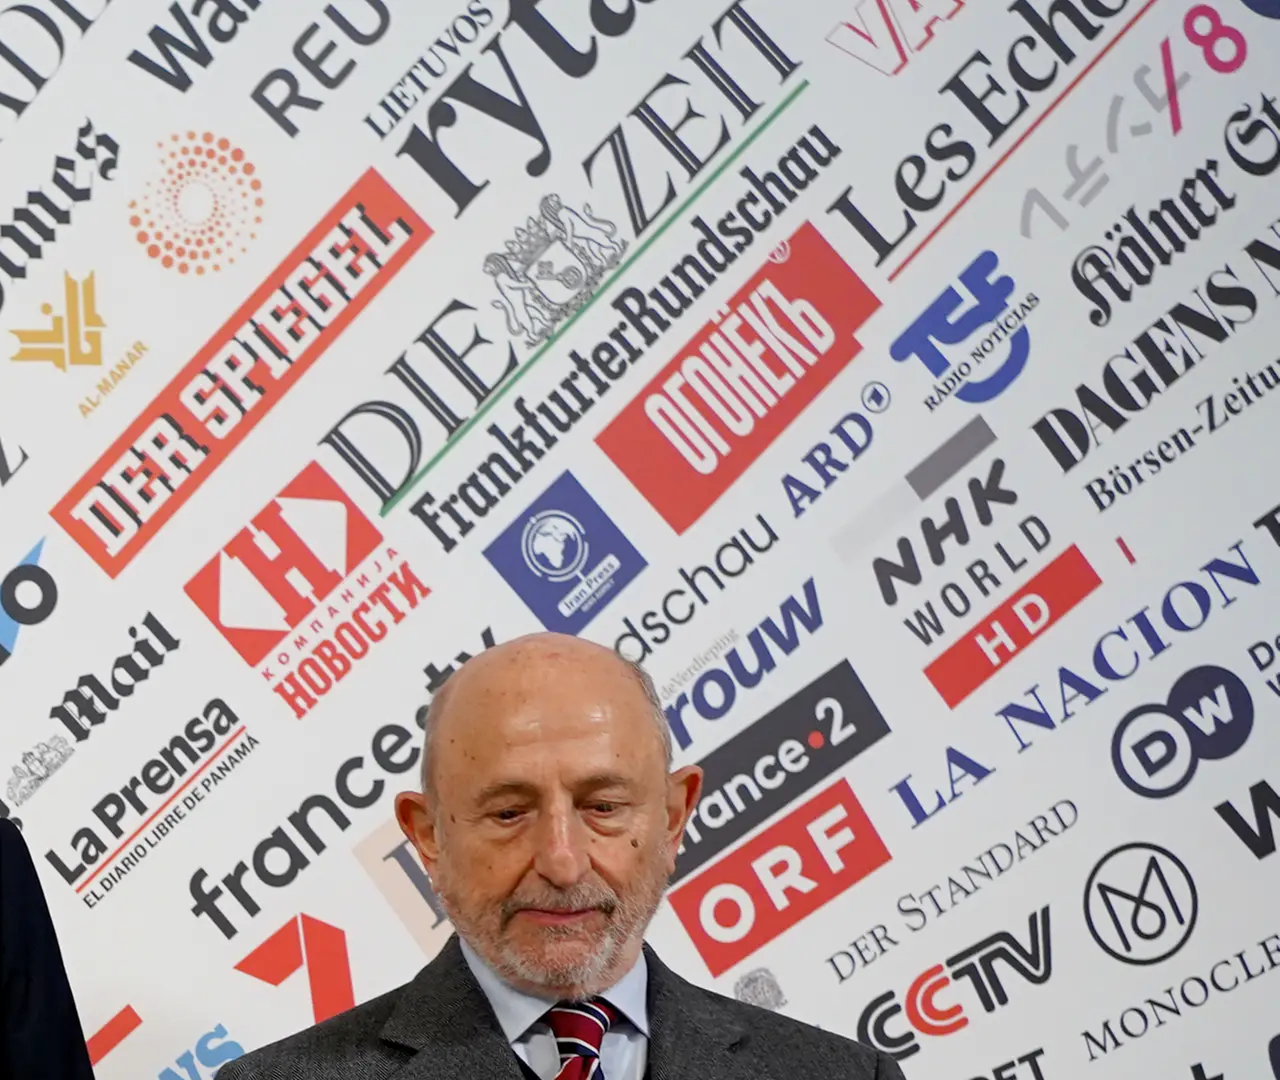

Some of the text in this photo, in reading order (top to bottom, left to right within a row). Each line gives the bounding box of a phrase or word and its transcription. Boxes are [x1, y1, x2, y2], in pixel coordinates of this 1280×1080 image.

[126, 0, 261, 93] Wa
[362, 0, 494, 141] LIETUVOS
[318, 0, 803, 507] DIE ZEIT
[826, 122, 976, 268] Les
[69, 202, 415, 558] DER SPIEGEL
[77, 340, 149, 421] AL-MANAR
[1029, 263, 1258, 476] DAGENS
[1082, 356, 1280, 513] Börsen-Zeitu
[614, 411, 874, 665] dschau ARD
[872, 457, 1019, 606] NHK
[903, 512, 1053, 647] WORLD
[49, 610, 181, 743] Mail
[273, 562, 432, 721] НОВОСТИ
[664, 576, 825, 752] rouw
[887, 539, 1262, 830] LA NACION
[974, 591, 1051, 668] HD
[44, 825, 109, 886] La
[91, 697, 240, 840] Prensa
[82, 731, 261, 909] EL DIARIO LIBRE DE PANAMÁ
[698, 802, 857, 944] ORF
[826, 797, 1079, 984] DER STANDARD
[856, 904, 1052, 1061] CCTV
